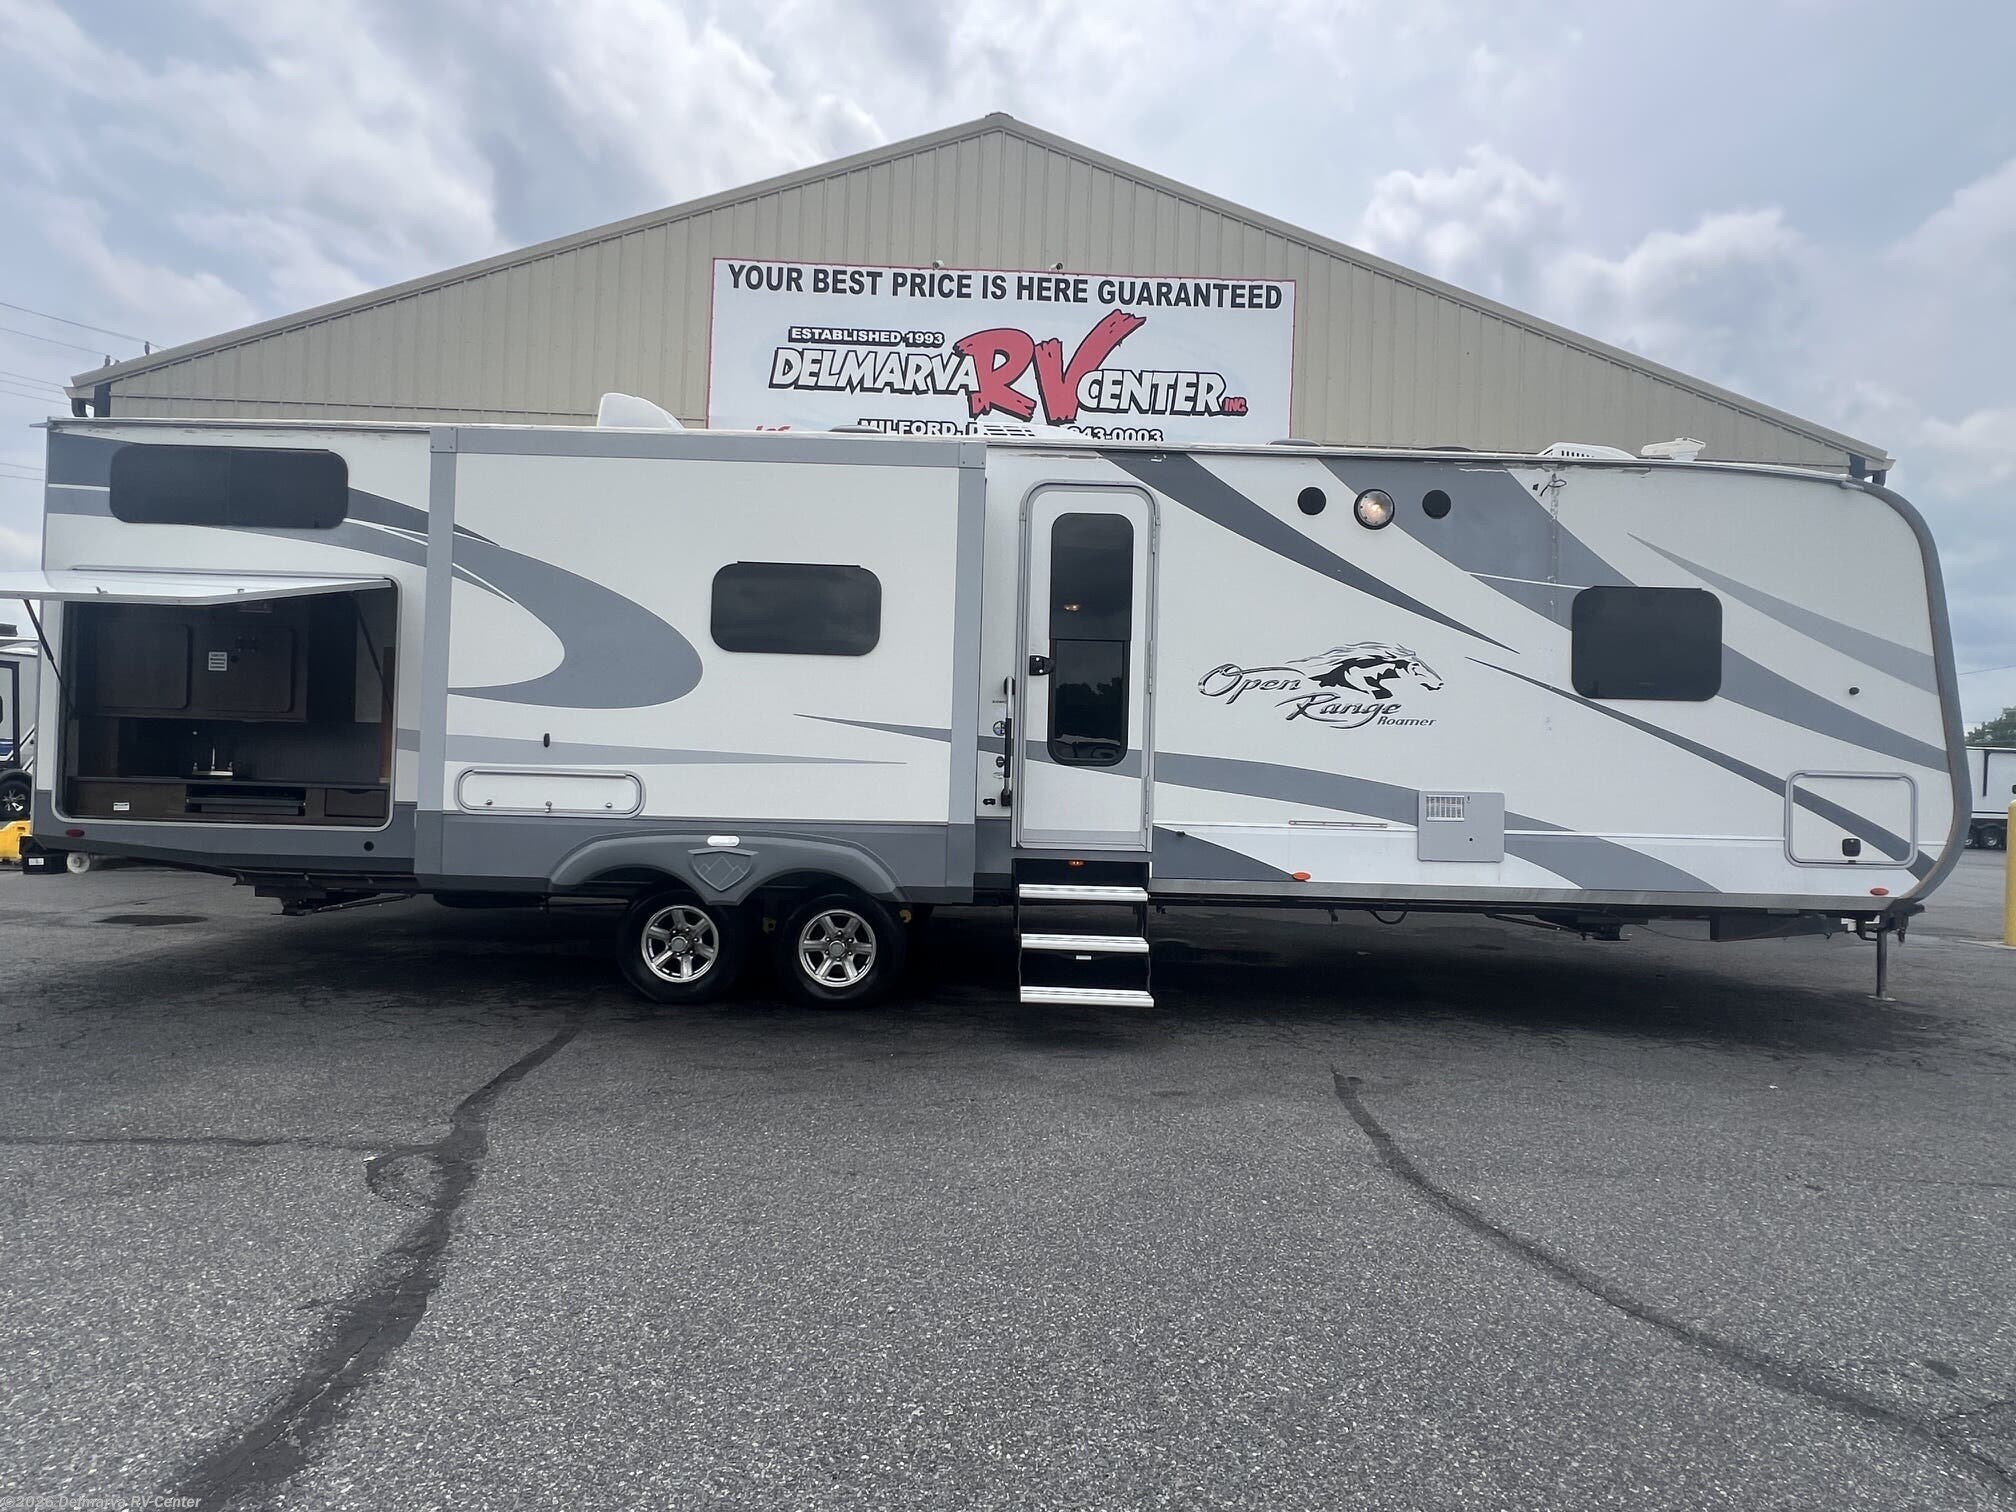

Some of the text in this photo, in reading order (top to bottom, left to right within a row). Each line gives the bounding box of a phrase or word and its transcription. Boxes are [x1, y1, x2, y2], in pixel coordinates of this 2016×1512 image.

[728, 264, 1283, 309] YOUR BEST PRICE IS HERE GUARANTEED
[788, 327, 945, 347] ESTABLISHED 1993
[769, 309, 1249, 425] DELMARVA RV CENTER INC.
[1198, 663, 1305, 704] Open
[1275, 692, 1401, 729] Range
[1377, 716, 1436, 727] Roamer
